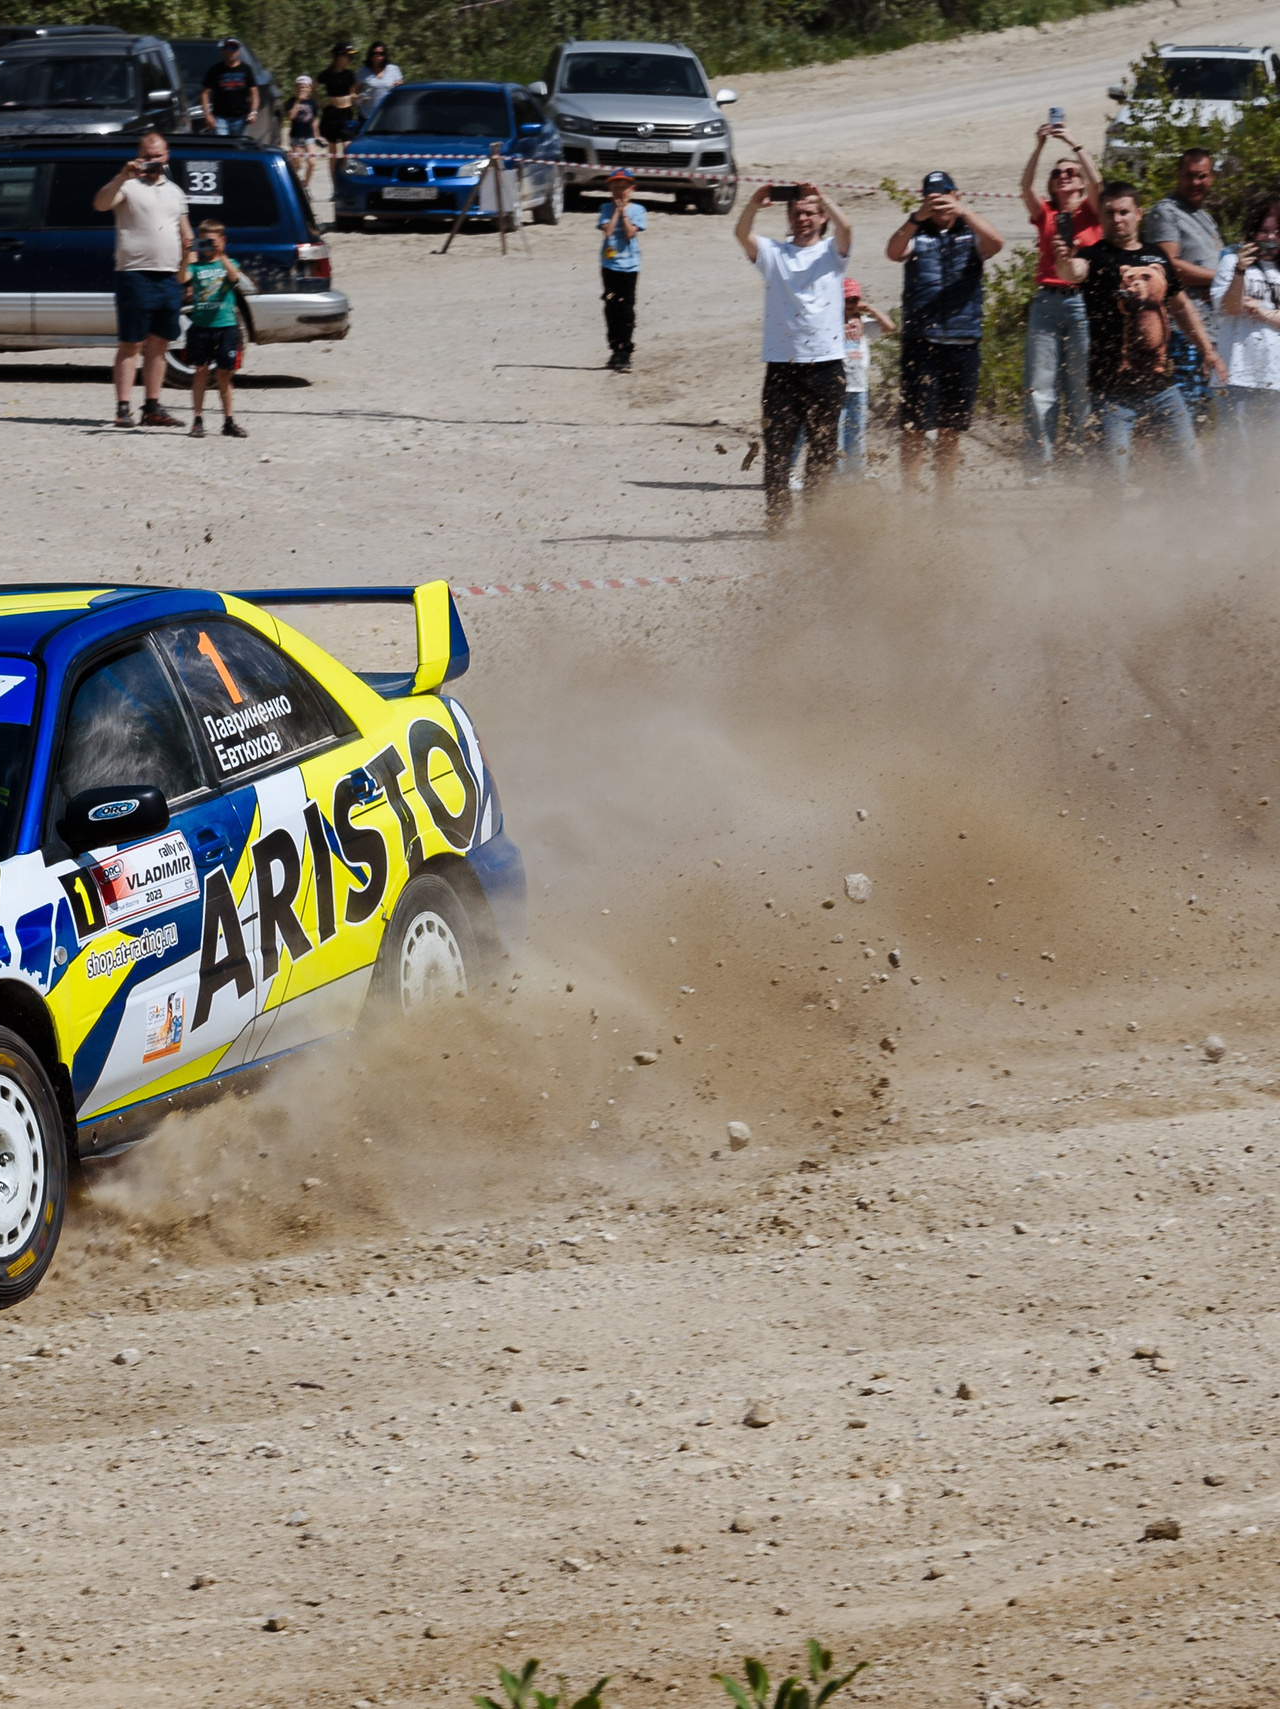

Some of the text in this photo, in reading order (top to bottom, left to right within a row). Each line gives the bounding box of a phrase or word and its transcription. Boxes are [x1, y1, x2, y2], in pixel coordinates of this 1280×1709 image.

[189, 172, 217, 191] 33
[197, 631, 243, 704] 1
[203, 694, 293, 743] Лавриненко
[214, 731, 282, 772] Евтюхов
[158, 840, 187, 859] rally in
[125, 855, 192, 890] VLADIMIR
[190, 718, 478, 1034] ARISTO
[74, 876, 95, 926] 1
[145, 888, 163, 903] 2023
[86, 922, 179, 979] shop.at-racing.ru
